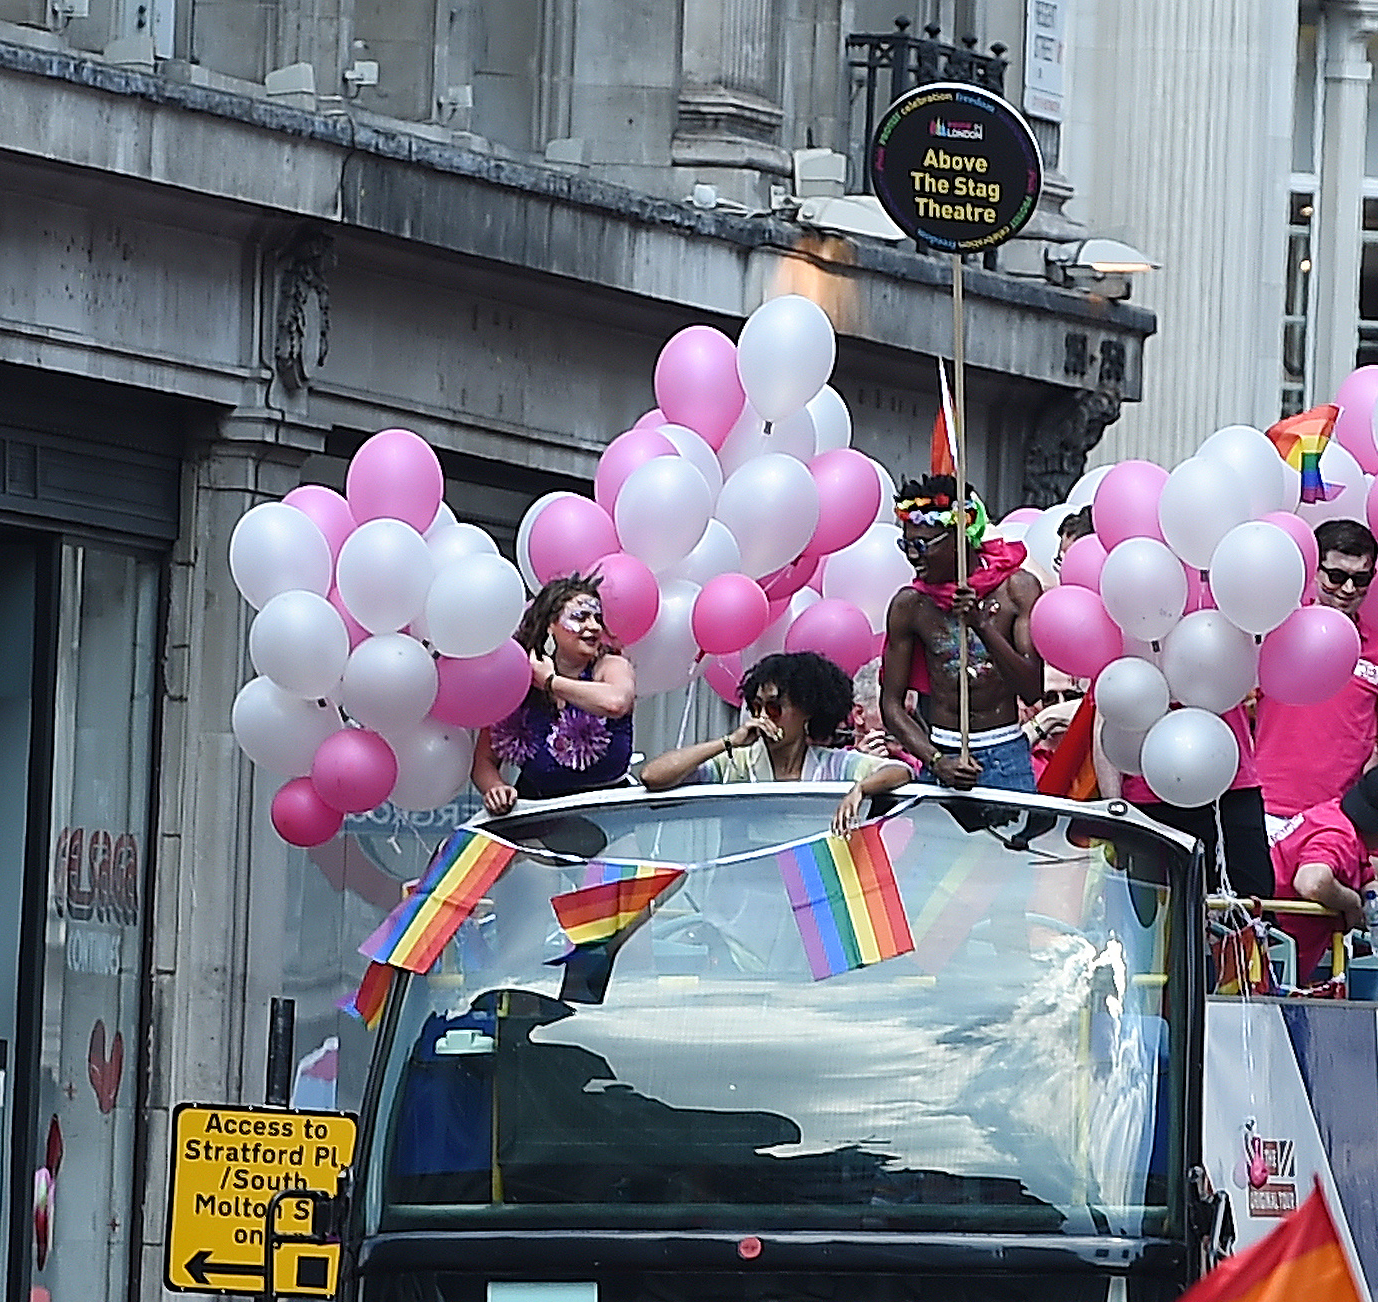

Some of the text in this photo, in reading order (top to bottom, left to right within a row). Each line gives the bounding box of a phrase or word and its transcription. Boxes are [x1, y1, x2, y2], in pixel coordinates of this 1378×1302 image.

[923, 148, 989, 174] Above
[910, 170, 950, 194] The
[953, 176, 1001, 203] Stag
[914, 197, 998, 224] Theatre
[204, 1112, 328, 1139] Access to
[184, 1138, 304, 1166] Stratford
